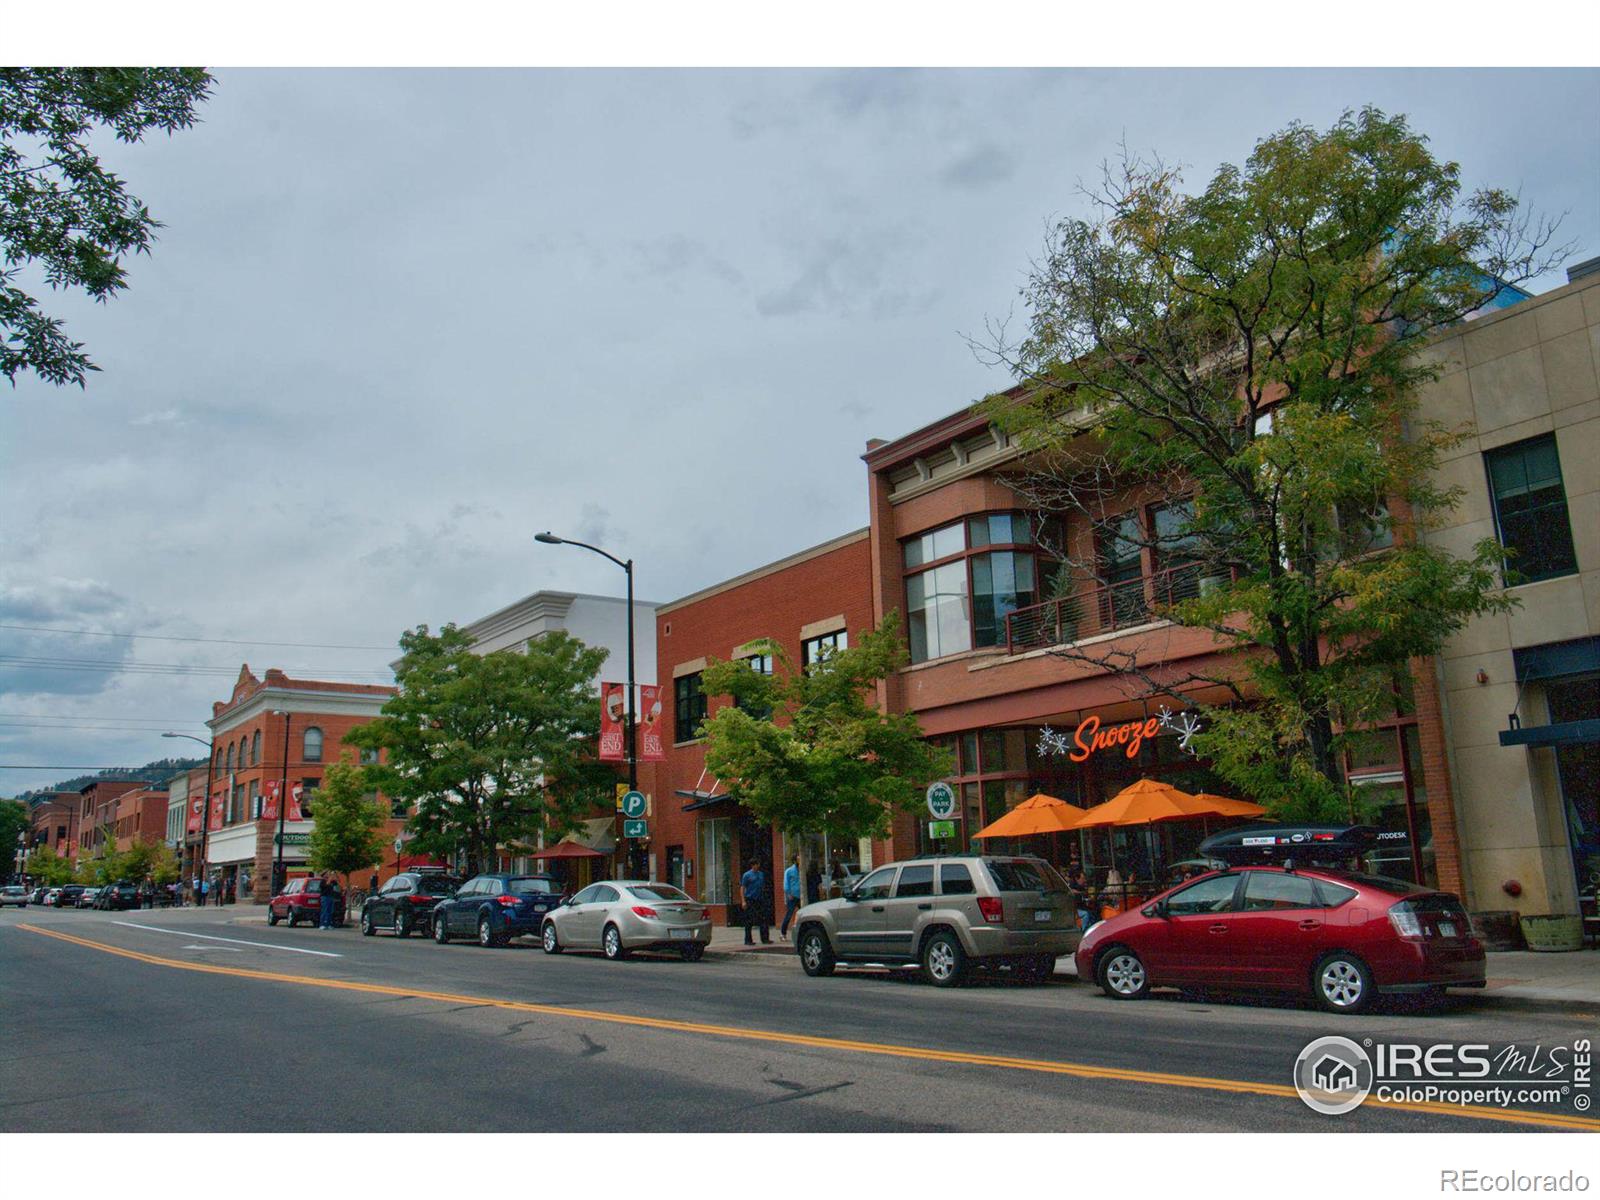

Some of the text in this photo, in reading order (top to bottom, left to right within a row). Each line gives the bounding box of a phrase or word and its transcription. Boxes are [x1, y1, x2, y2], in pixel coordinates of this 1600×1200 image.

[602, 741, 621, 752] END
[1069, 715, 1160, 762] Snooze
[628, 796, 641, 813] P
